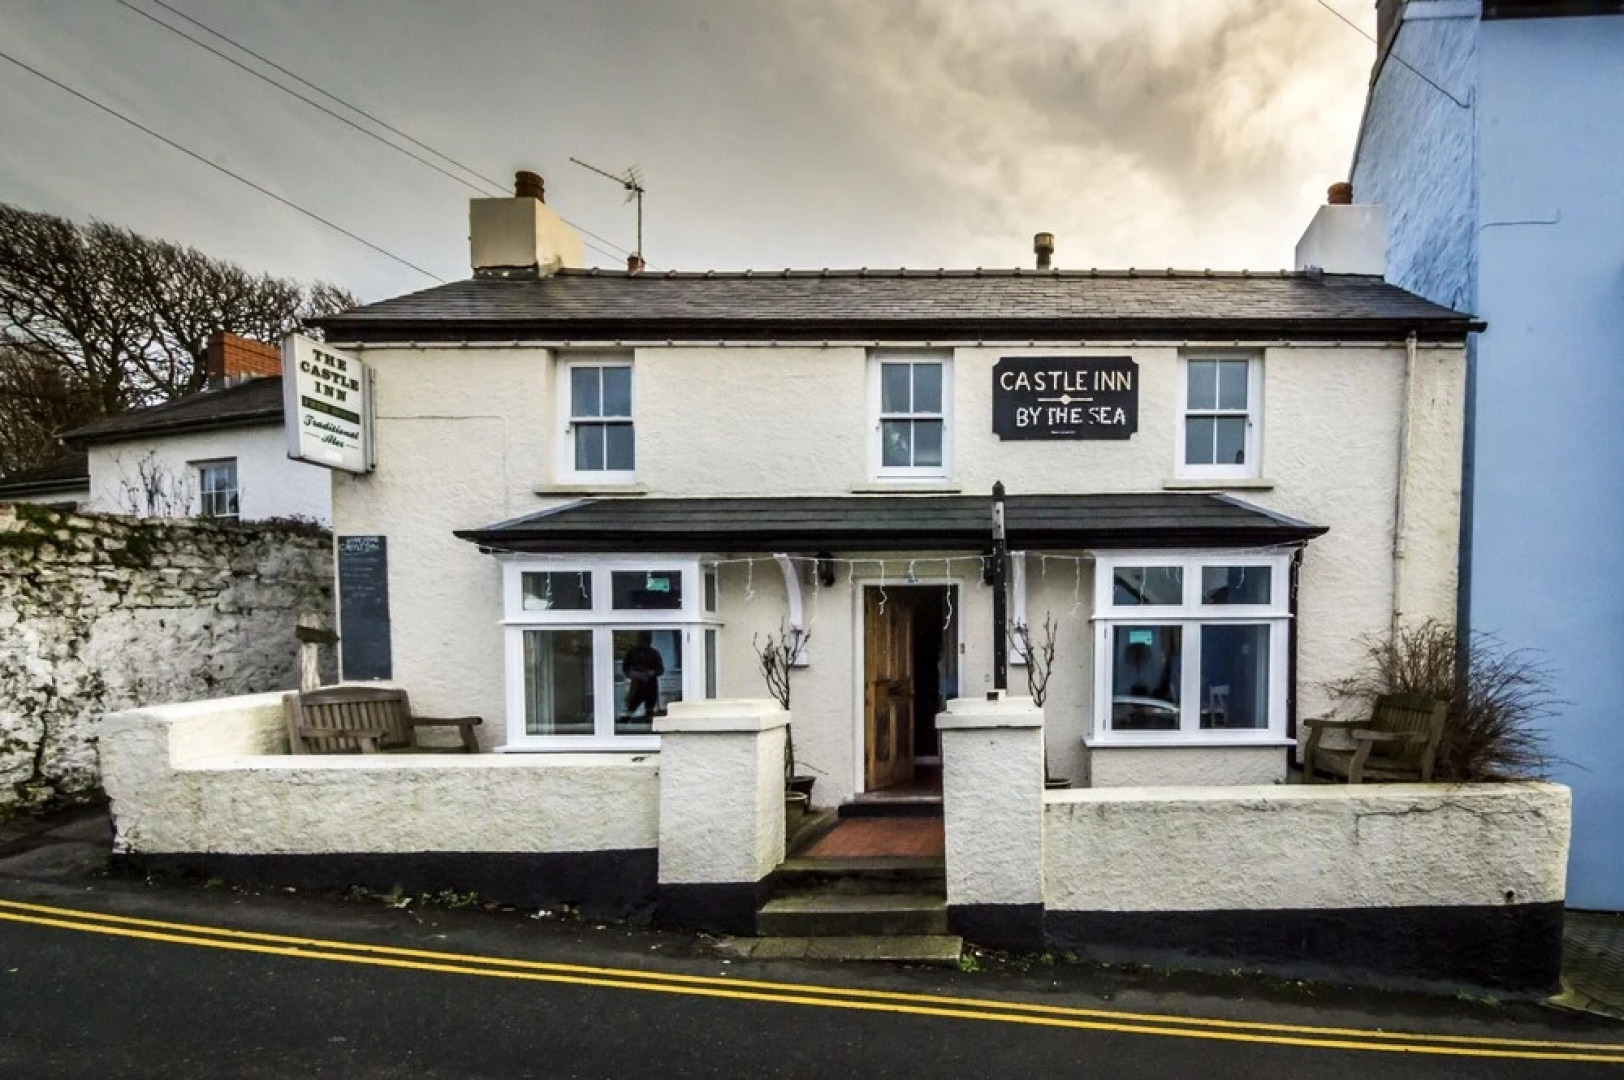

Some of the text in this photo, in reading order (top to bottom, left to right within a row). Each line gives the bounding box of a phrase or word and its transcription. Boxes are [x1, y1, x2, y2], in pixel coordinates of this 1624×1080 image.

[312, 348, 347, 372] THE
[300, 361, 360, 391] CASTLE
[1000, 370, 1131, 391] CASTLE INN
[315, 381, 347, 401] INN
[303, 414, 360, 439] Traditional
[1016, 406, 1127, 427] BY THE SEA
